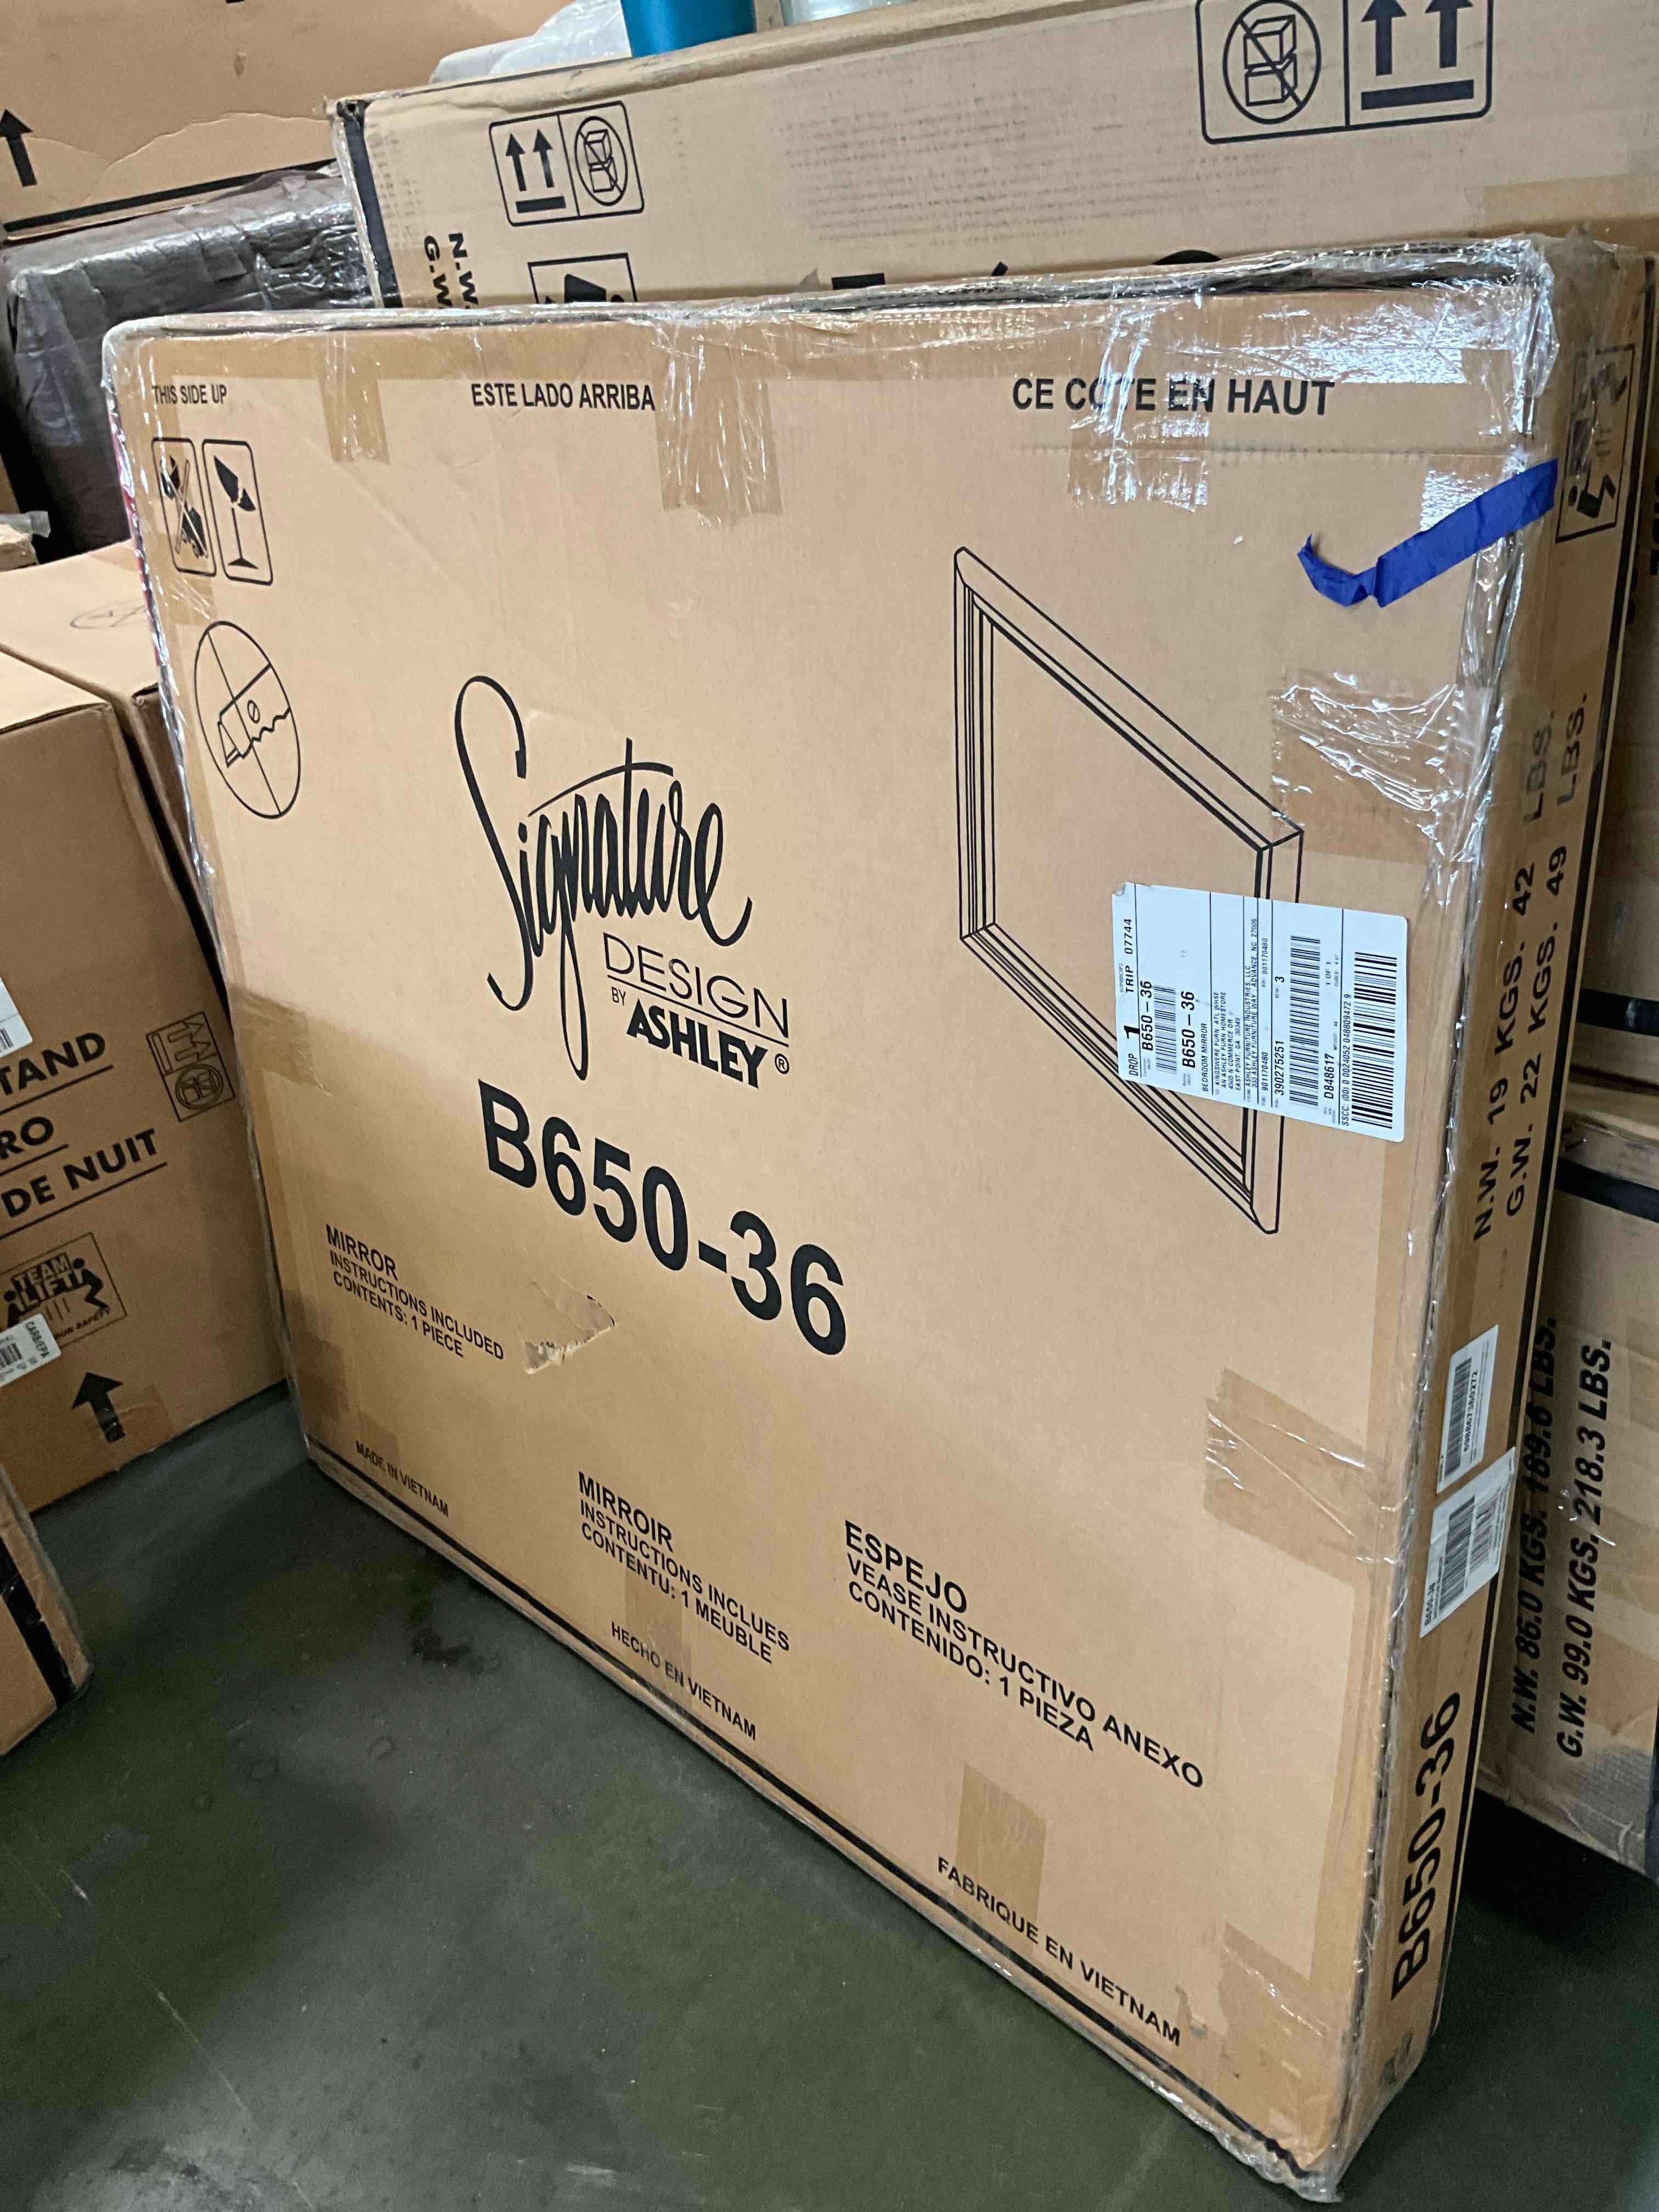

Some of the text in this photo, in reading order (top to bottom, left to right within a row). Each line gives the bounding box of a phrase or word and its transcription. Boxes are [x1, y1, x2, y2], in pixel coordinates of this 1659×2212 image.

[152, 385, 227, 404] THIS SIDE UP
[471, 382, 656, 411] ESTE LADO ARRIBA
[1013, 378, 1335, 416] CE COE EN HAUT
[455, 675, 752, 1080] Signature
[1512, 862, 1534, 916] 42
[603, 932, 789, 1039] DESIGN
[1124, 918, 1141, 1076] DROP 1 TRIP 07744
[1325, 969, 1331, 979] OF
[1494, 941, 1525, 1056] KGS.
[1506, 693, 1588, 1217] G.W. 22 KGS. 49 LBS.
[612, 987, 768, 1088] BY ASHLEY
[1227, 1019, 1233, 1029] DR
[1342, 1000, 1351, 1043] 048809472
[1342, 1045, 1351, 1077] 0024052
[1221, 1079, 1227, 1089] AN
[1274, 1040, 1285, 1096] 390275251
[1324, 1053, 1335, 1099] D848617
[1487, 1077, 1509, 1125] 19
[1, 1128, 157, 1218] DE NUIT
[1474, 1146, 1500, 1242] N.W.
[326, 1223, 398, 1281] MIRROR
[478, 1079, 847, 1356] B650-36
[13, 1254, 71, 1290] TEAM
[330, 1250, 504, 1361] INSTRUCTIONS INCLUDED
[334, 1271, 464, 1358] CONTENTS: 1 PIECE
[356, 1440, 449, 1518] MADE IN VIETNAM
[579, 1471, 674, 1552] MIRROIR
[580, 1499, 790, 1651] INSTRUCTIONS INCLUES
[845, 1520, 967, 1614] ESPEJO
[1519, 1510, 1548, 1587] KGS.
[1556, 1338, 1612, 1758] G.W. 99.0 KGS. 218.3 LBS.
[582, 1522, 772, 1664] CONTENTU: 1 MEUBLE
[611, 1621, 757, 1741] HECHO EN VIETNAM
[847, 1553, 1204, 1788] VEASE INSTRUCTIVO ANEXO
[849, 1581, 1094, 1752] CONTENIDO: 1 PIEZA
[1511, 1666, 1539, 1734] N.W.
[1392, 1692, 1461, 2001] B650-36
[938, 1855, 1181, 2047] FABRIQUE EN VIETNAM
